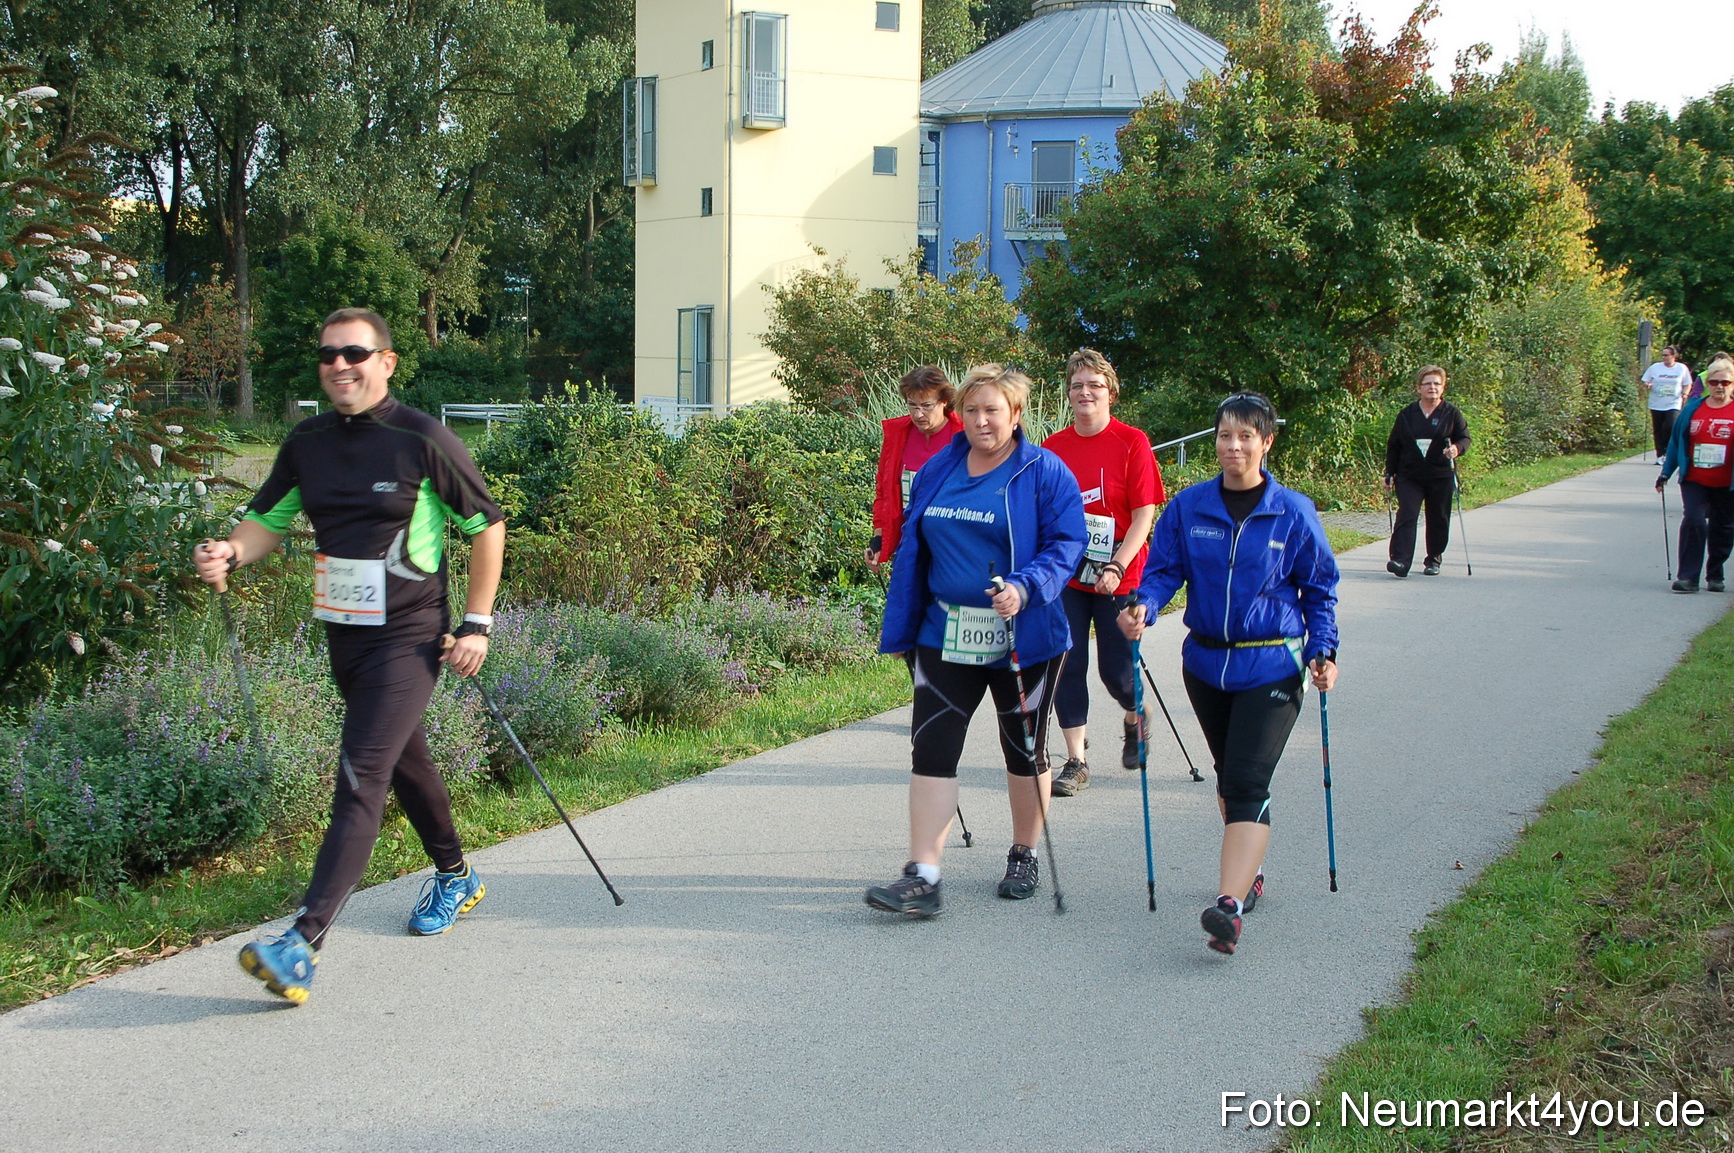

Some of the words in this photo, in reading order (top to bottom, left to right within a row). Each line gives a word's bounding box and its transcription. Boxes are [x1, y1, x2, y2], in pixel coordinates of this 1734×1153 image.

[329, 582, 377, 602] 8052
[962, 611, 995, 625] Simone
[962, 629, 1006, 645] 8093
